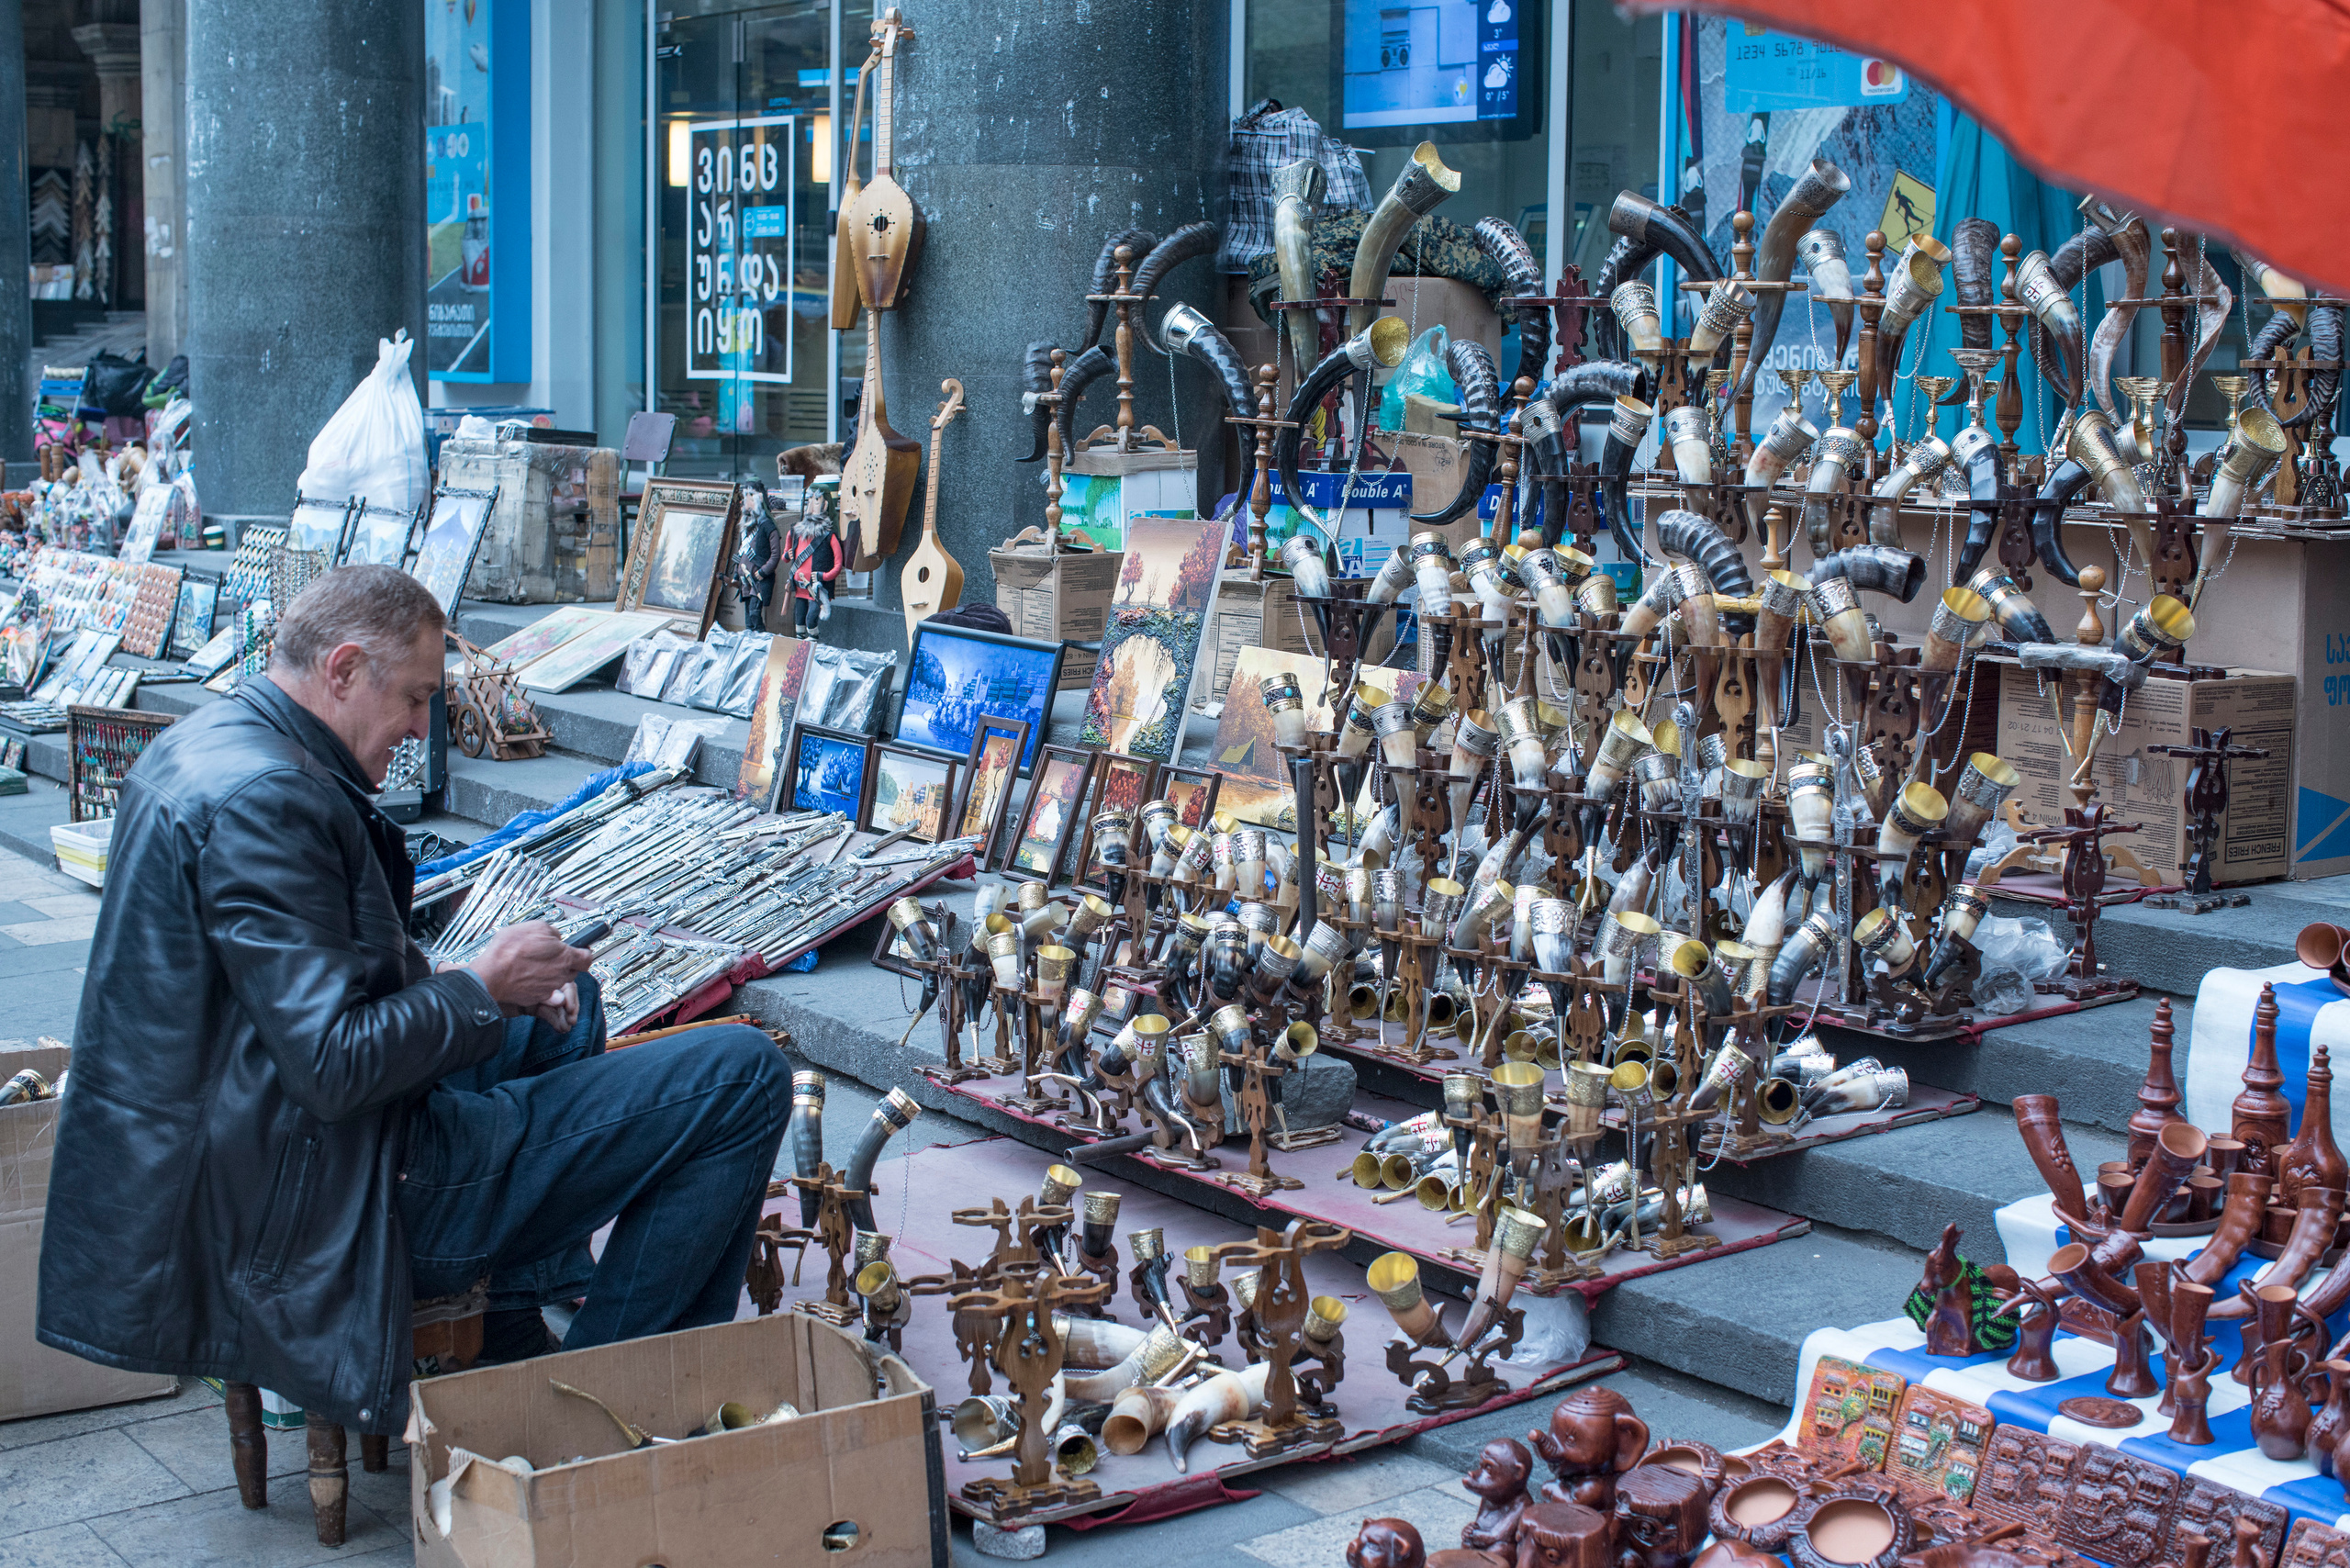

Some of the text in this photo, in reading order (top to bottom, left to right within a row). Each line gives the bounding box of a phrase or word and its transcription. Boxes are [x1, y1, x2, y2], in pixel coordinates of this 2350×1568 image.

[1736, 44, 1766, 61] 1234
[1774, 41, 1804, 58] 5678
[698, 143, 778, 194] ვინც
[697, 199, 735, 248] არ
[697, 252, 779, 301] უნდა
[697, 307, 764, 356] იყო
[1341, 484, 1389, 498] Double
[2326, 633, 2350, 664] სა
[1063, 668, 1081, 677] FRIES
[2008, 721, 2030, 732] 21:02
[2031, 724, 2042, 734] 17
[2044, 726, 2053, 735] 04
[2039, 813, 2062, 825] WRIN
[2228, 842, 2281, 857] FRENCH FRIES
